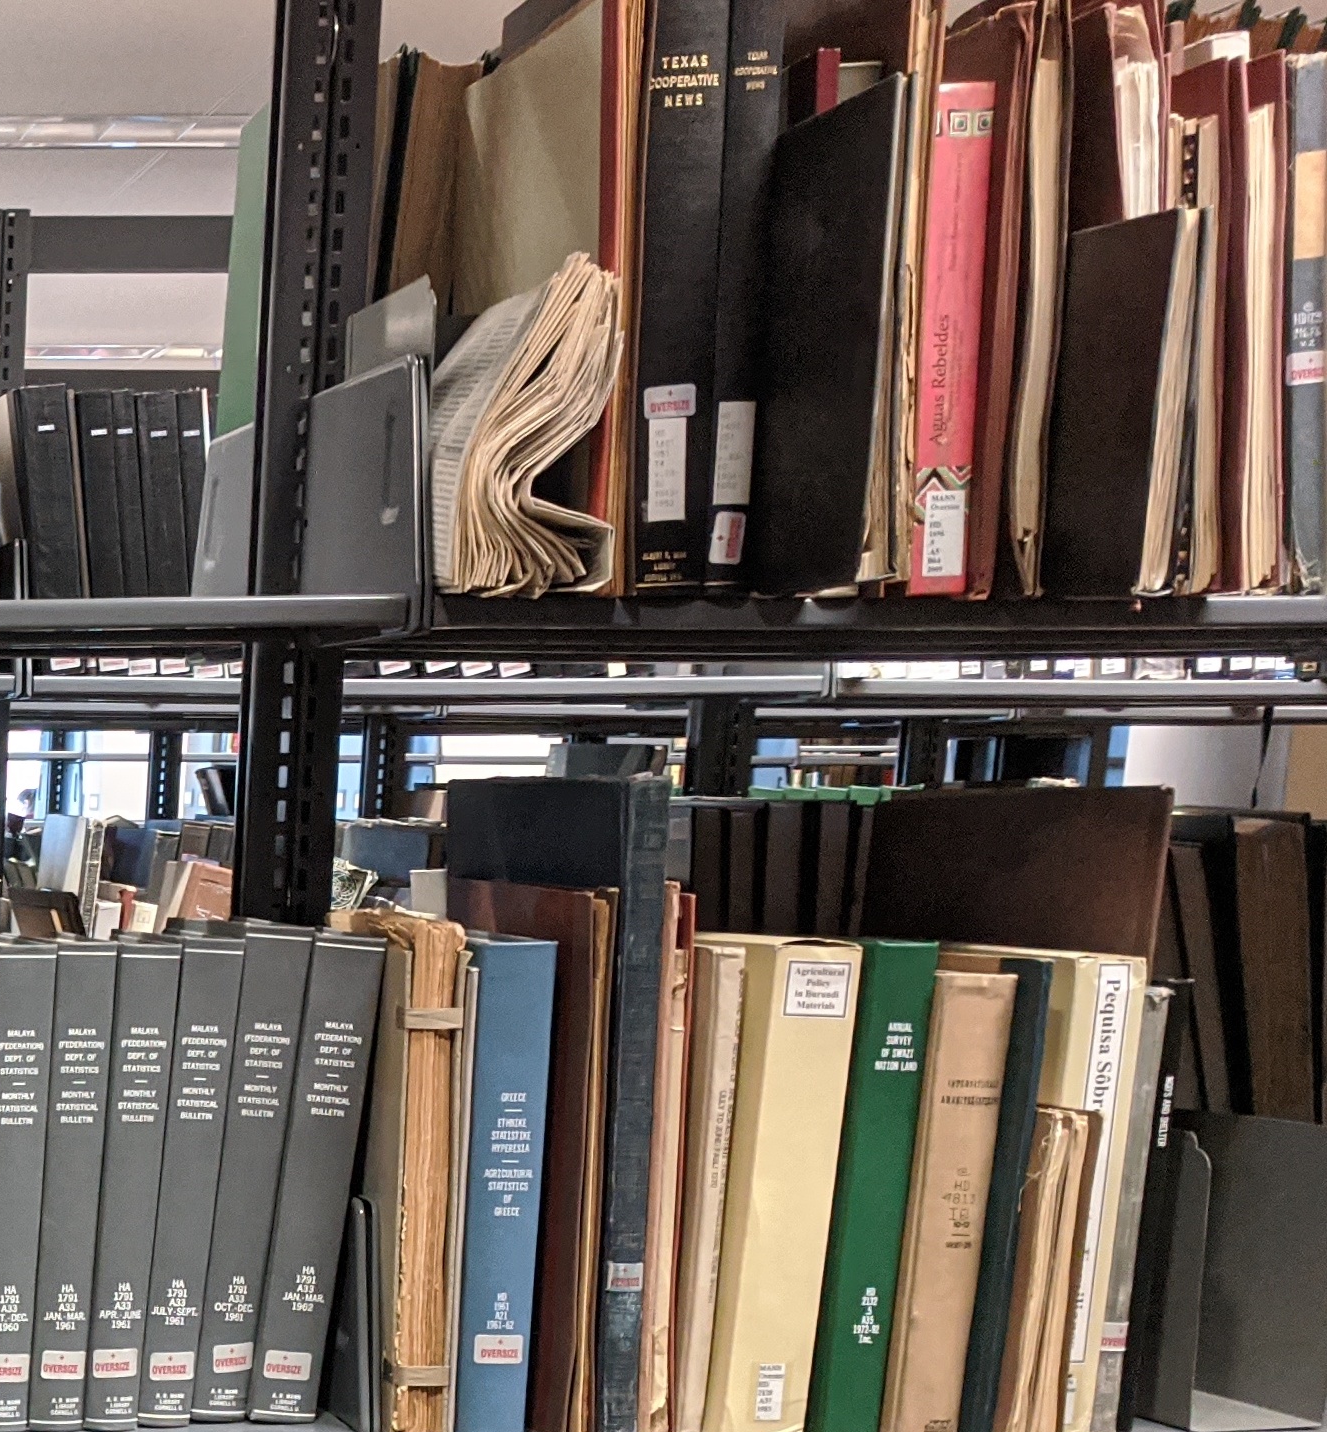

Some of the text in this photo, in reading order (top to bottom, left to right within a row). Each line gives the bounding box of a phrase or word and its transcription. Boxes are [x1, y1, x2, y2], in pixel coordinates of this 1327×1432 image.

[661, 54, 709, 70] TEXAS
[649, 73, 720, 91] COOPERATIVE
[664, 92, 704, 108] NEWS
[928, 313, 950, 446] Aguas Rebeldes
[793, 965, 846, 978] Agricultural
[804, 978, 831, 989] Policy
[804, 989, 840, 1000] Burundi
[796, 1000, 836, 1011] Materials
[1091, 978, 1122, 1113] Pequisa Sôbr
[500, 1092, 528, 1103] GREECE
[487, 1181, 529, 1192] STATISTICS
[479, 1347, 520, 1360] OVERSIZE
